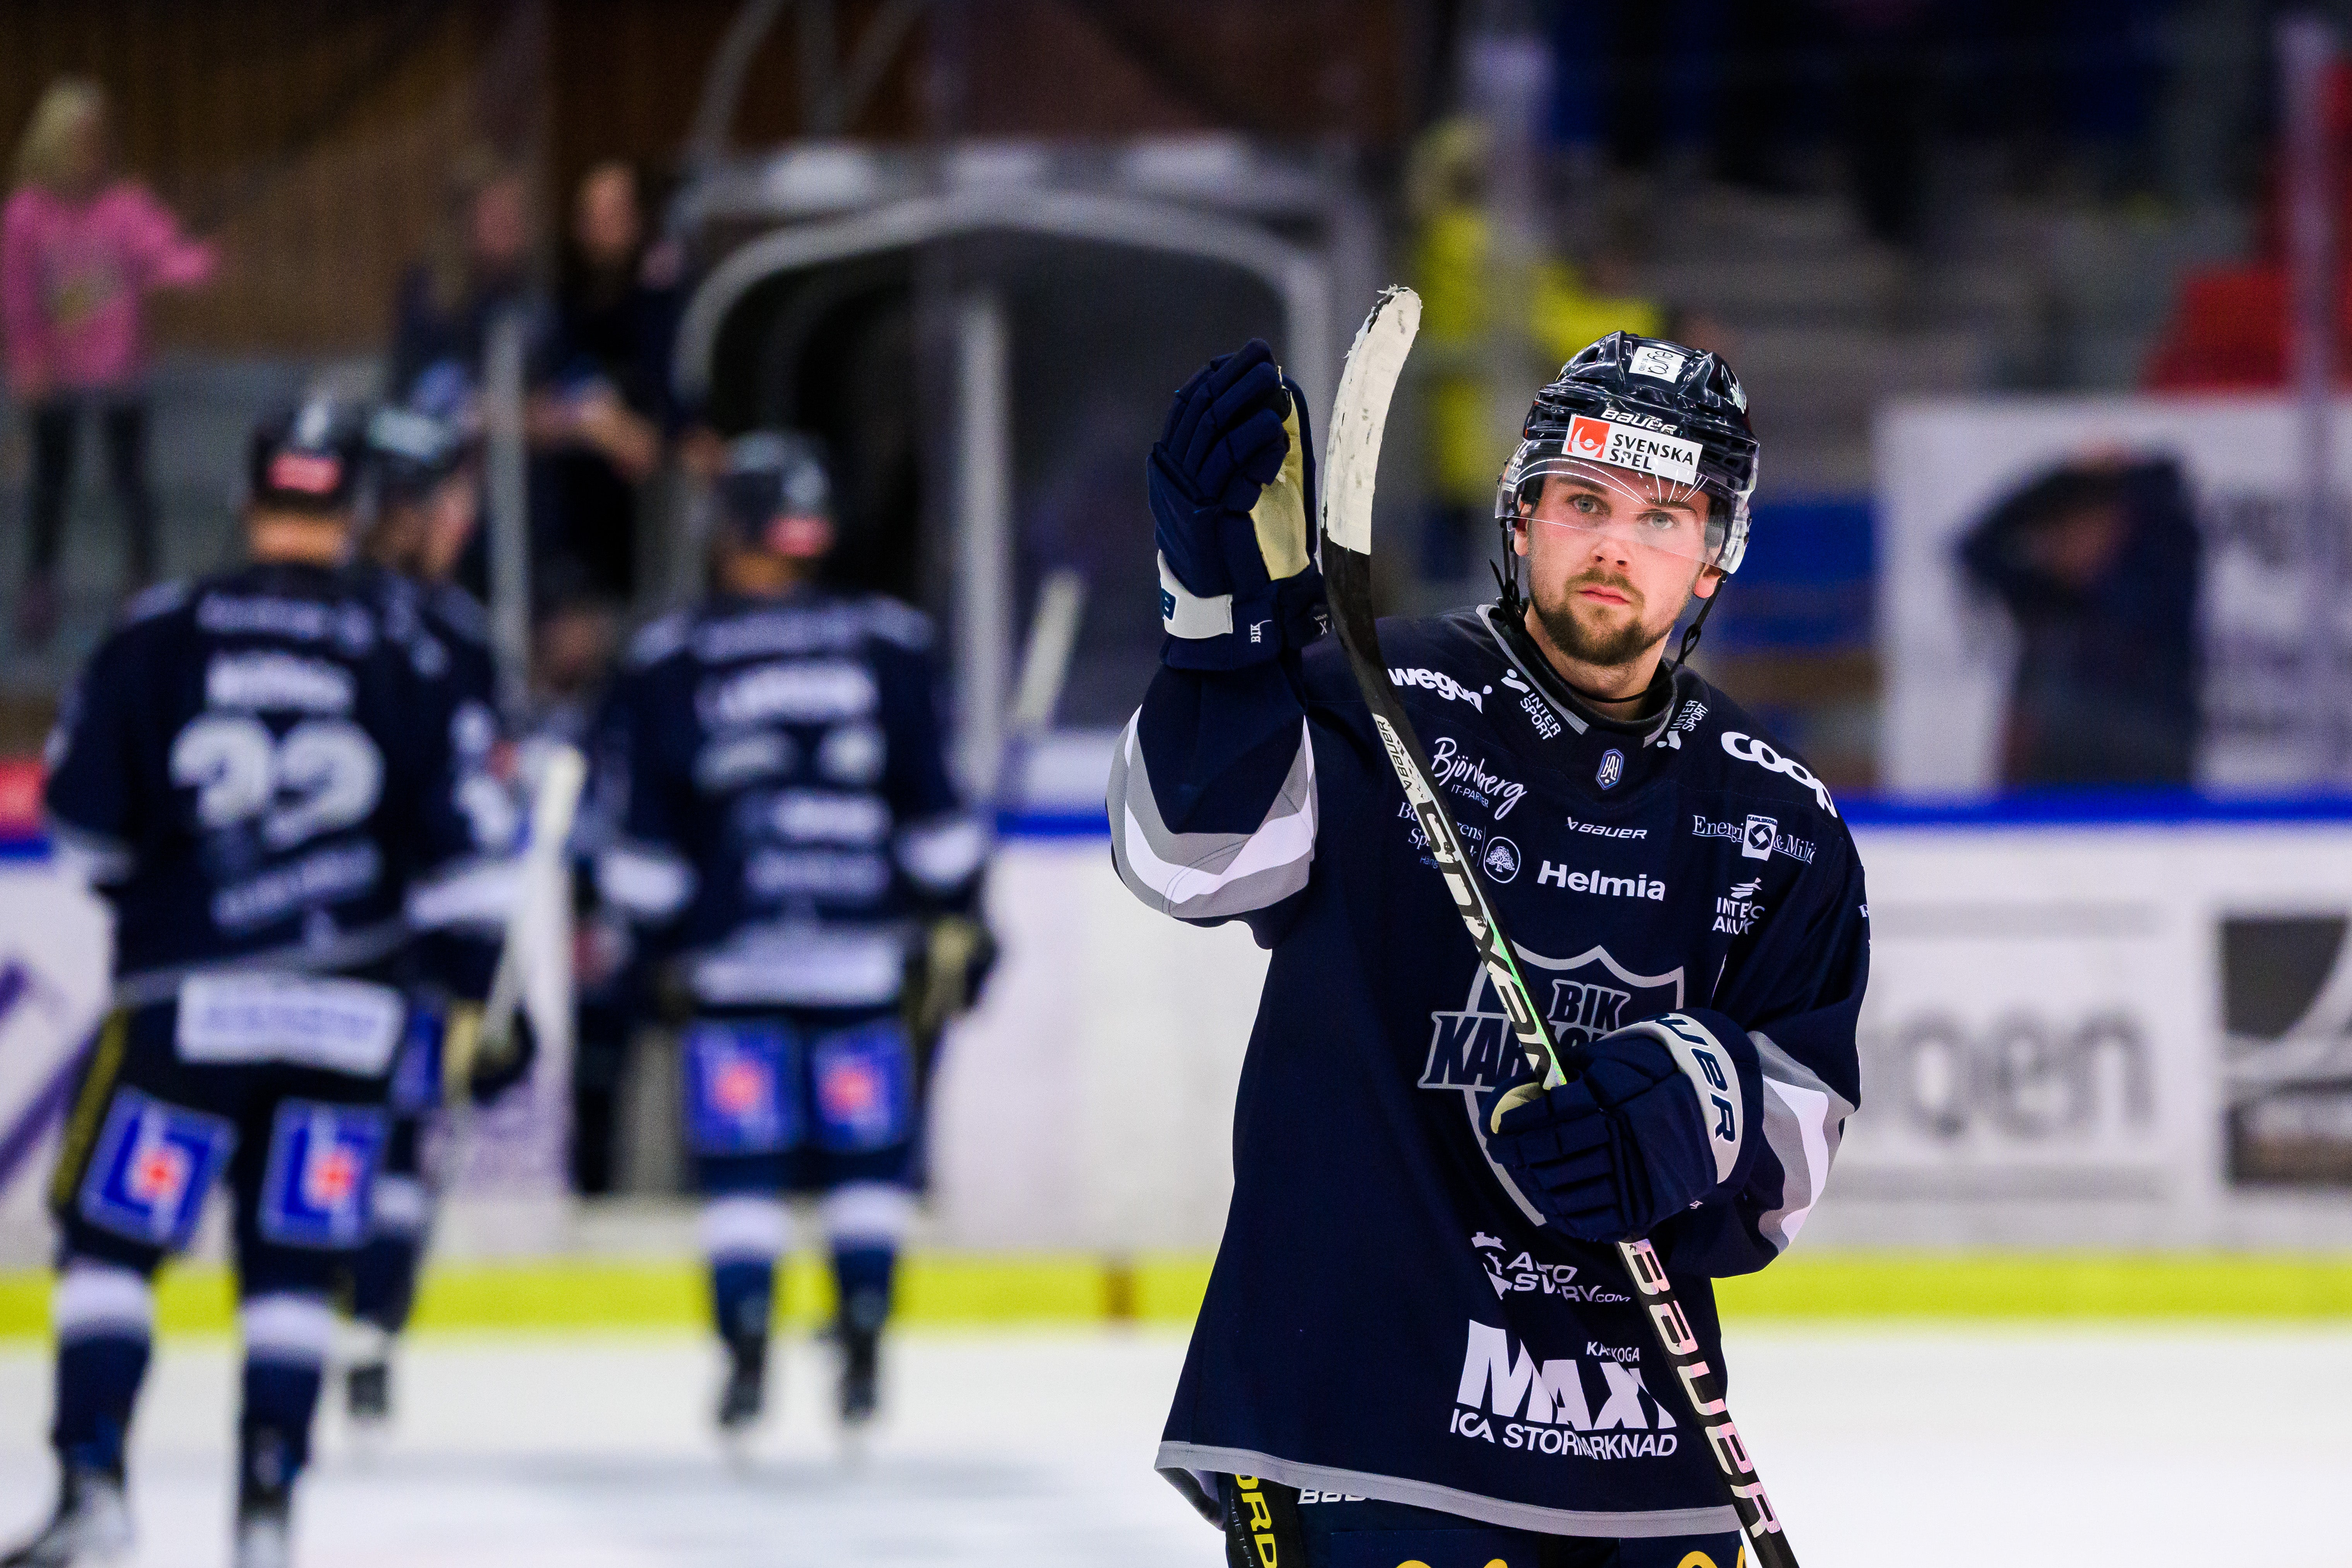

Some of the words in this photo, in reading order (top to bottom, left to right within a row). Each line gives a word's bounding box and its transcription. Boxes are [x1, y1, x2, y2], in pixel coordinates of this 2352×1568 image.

[1601, 409, 1678, 435] BAUER
[1609, 449, 1652, 470] SPEL
[1613, 434, 1693, 466] SVENSKA
[1520, 697, 1553, 740] SPORT
[1528, 692, 1561, 735] INTER
[1670, 700, 1699, 729] INTER
[1682, 703, 1708, 732] SPORT
[1721, 731, 1838, 818] coop
[1578, 826, 1647, 840] BAUER
[1692, 815, 1744, 843] Energi
[1773, 835, 1784, 850] &
[1537, 860, 1666, 901] Helmia
[1547, 979, 1630, 1031] BIK
[1618, 1239, 1781, 1538] BAUER
[1450, 1409, 1495, 1443] ICA
